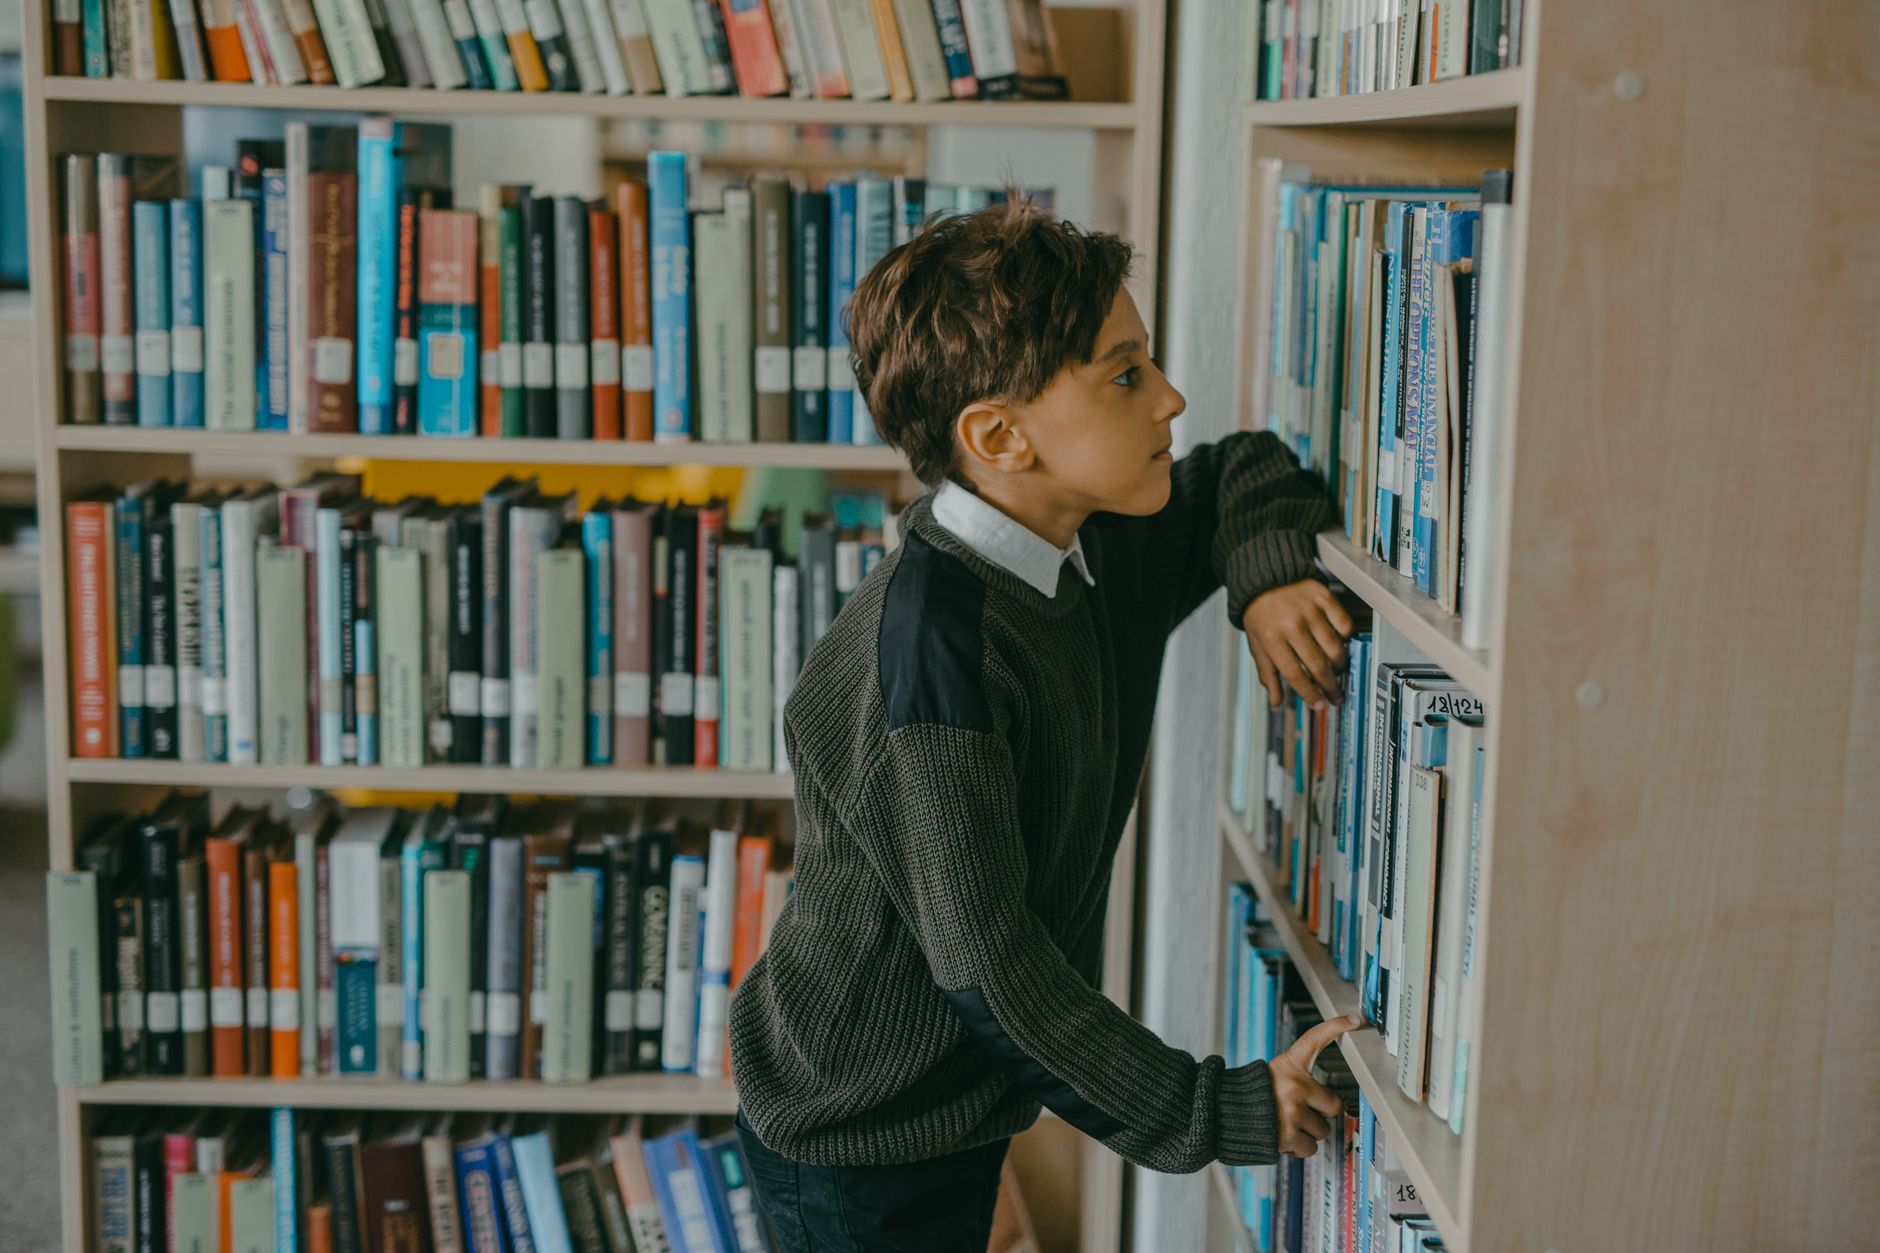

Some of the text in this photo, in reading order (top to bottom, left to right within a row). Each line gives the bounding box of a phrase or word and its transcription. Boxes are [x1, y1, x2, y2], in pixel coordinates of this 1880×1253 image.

[1411, 254, 1423, 299] THE
[1407, 301, 1423, 400] OPTIONS
[1424, 383, 1437, 472] FINANCIAL
[1375, 713, 1384, 817] INTERNATIONAL
[1386, 745, 1394, 833] INTERNATIONAL
[1401, 984, 1413, 1088] Production
